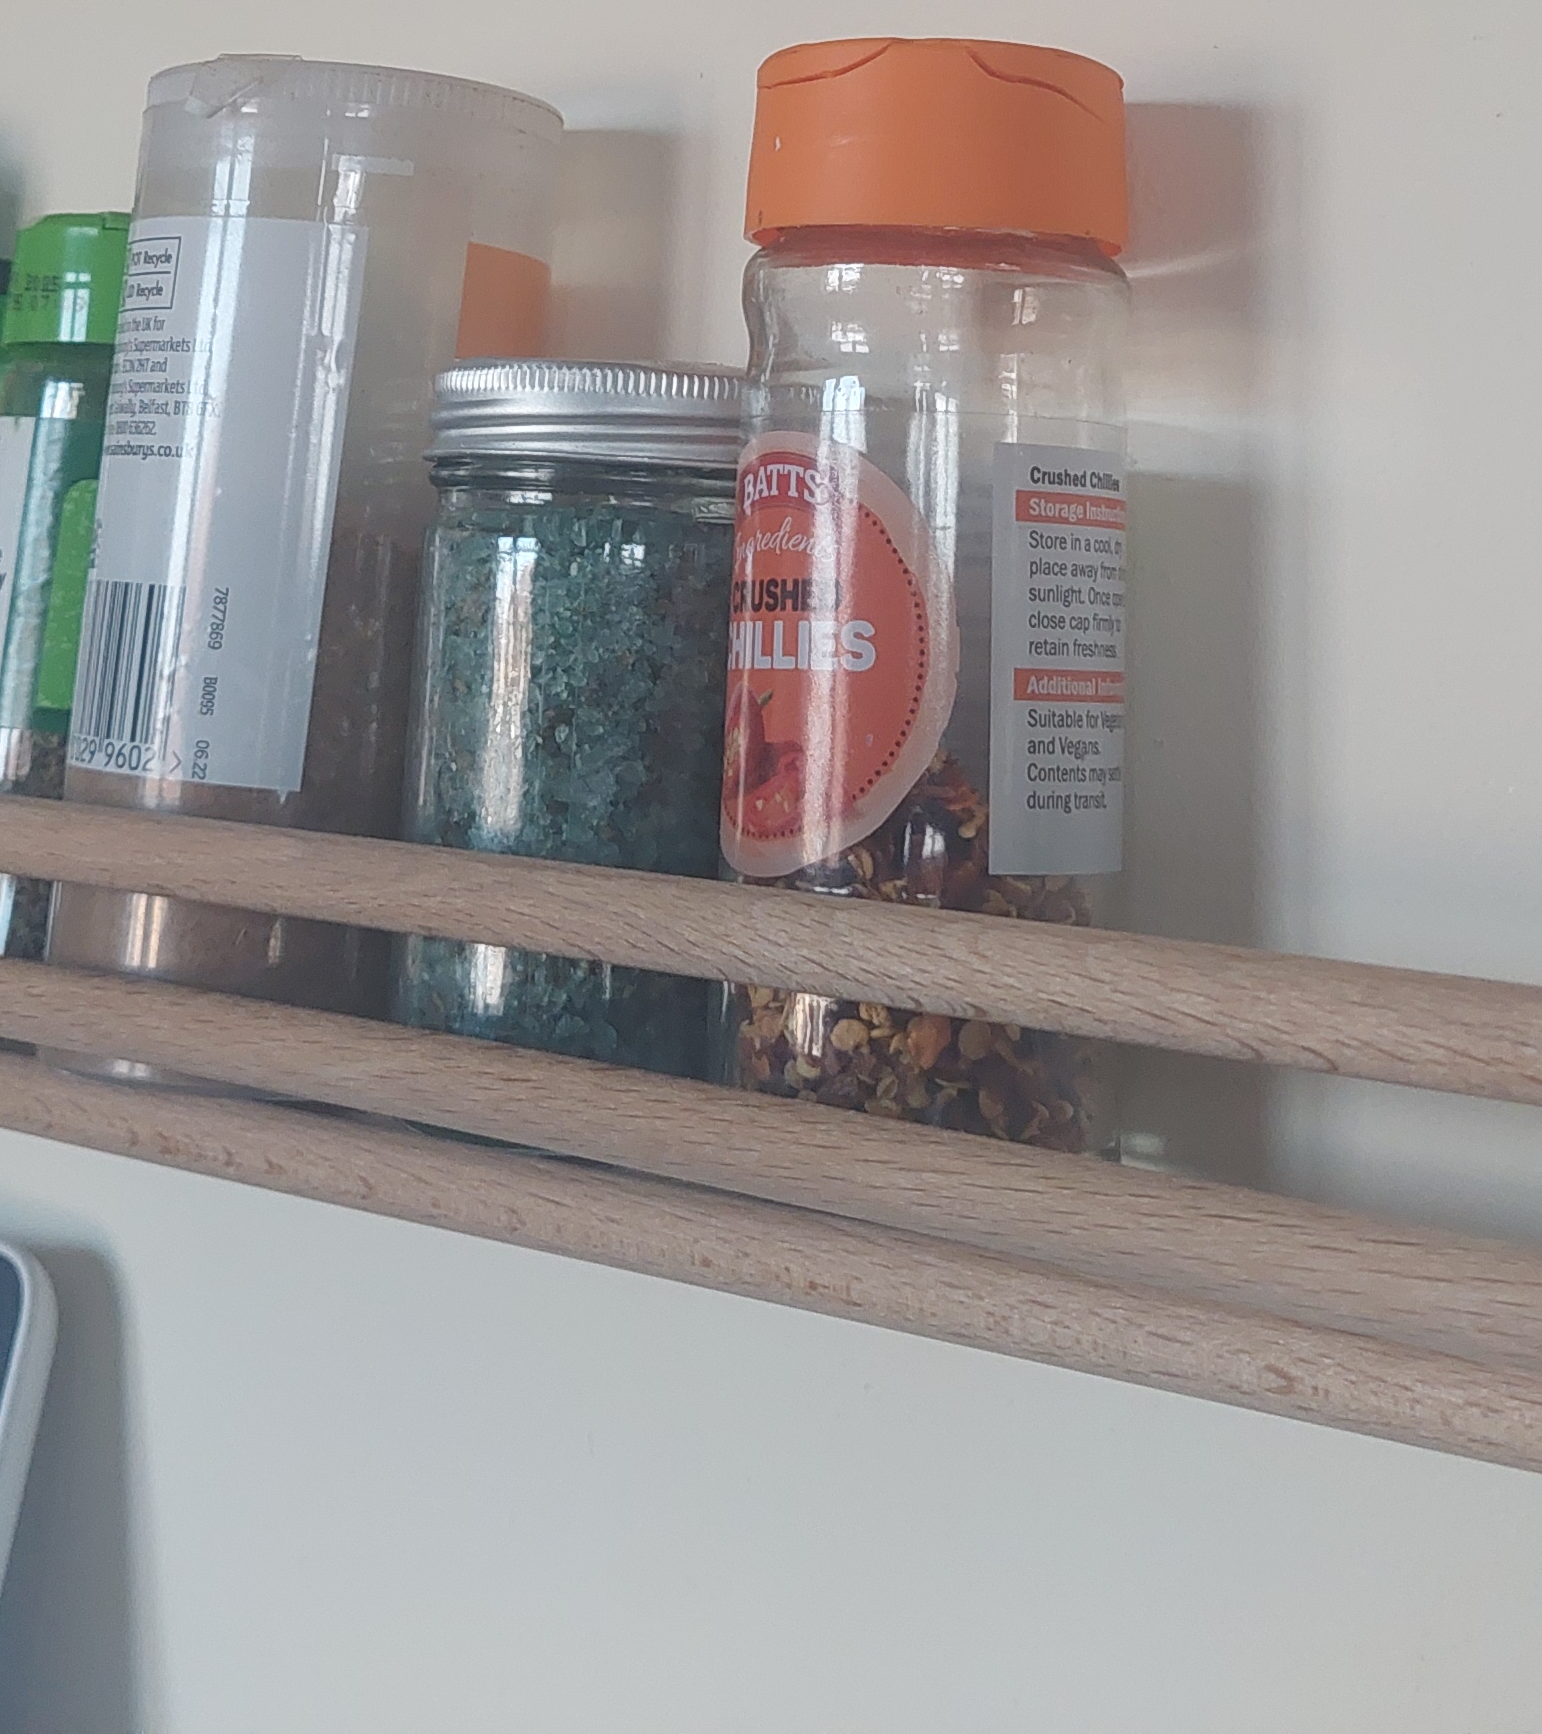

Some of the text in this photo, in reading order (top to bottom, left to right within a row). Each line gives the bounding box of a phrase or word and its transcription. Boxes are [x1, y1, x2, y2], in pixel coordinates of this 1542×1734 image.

[143, 247, 173, 269] Recycle
[153, 315, 167, 332] for
[150, 356, 169, 374] and
[742, 463, 827, 511] BATTS
[1029, 465, 1121, 493] Crushed Chillies
[1028, 497, 1084, 522] Storage
[1028, 529, 1068, 551] Store
[1070, 532, 1082, 553] in
[1083, 539, 1092, 553] a
[1029, 557, 1068, 579] place
[1070, 562, 1099, 583] away
[1028, 584, 1086, 608] sunlight.
[1087, 586, 1112, 607] Once
[208, 586, 231, 651] 7877869
[1028, 610, 1067, 630] close
[1069, 615, 1091, 635] cap
[728, 619, 877, 673] HILLIES
[1028, 637, 1071, 658] retain
[200, 675, 219, 717] B0095
[1026, 674, 1096, 697] Additional
[1026, 708, 1084, 730] Suitable
[1085, 709, 1100, 730] for
[191, 739, 211, 781] 06.22
[1026, 736, 1101, 761] and Vegans.
[1026, 762, 1088, 784] Contents
[1088, 768, 1108, 787] may
[1026, 790, 1108, 815] during transit.
